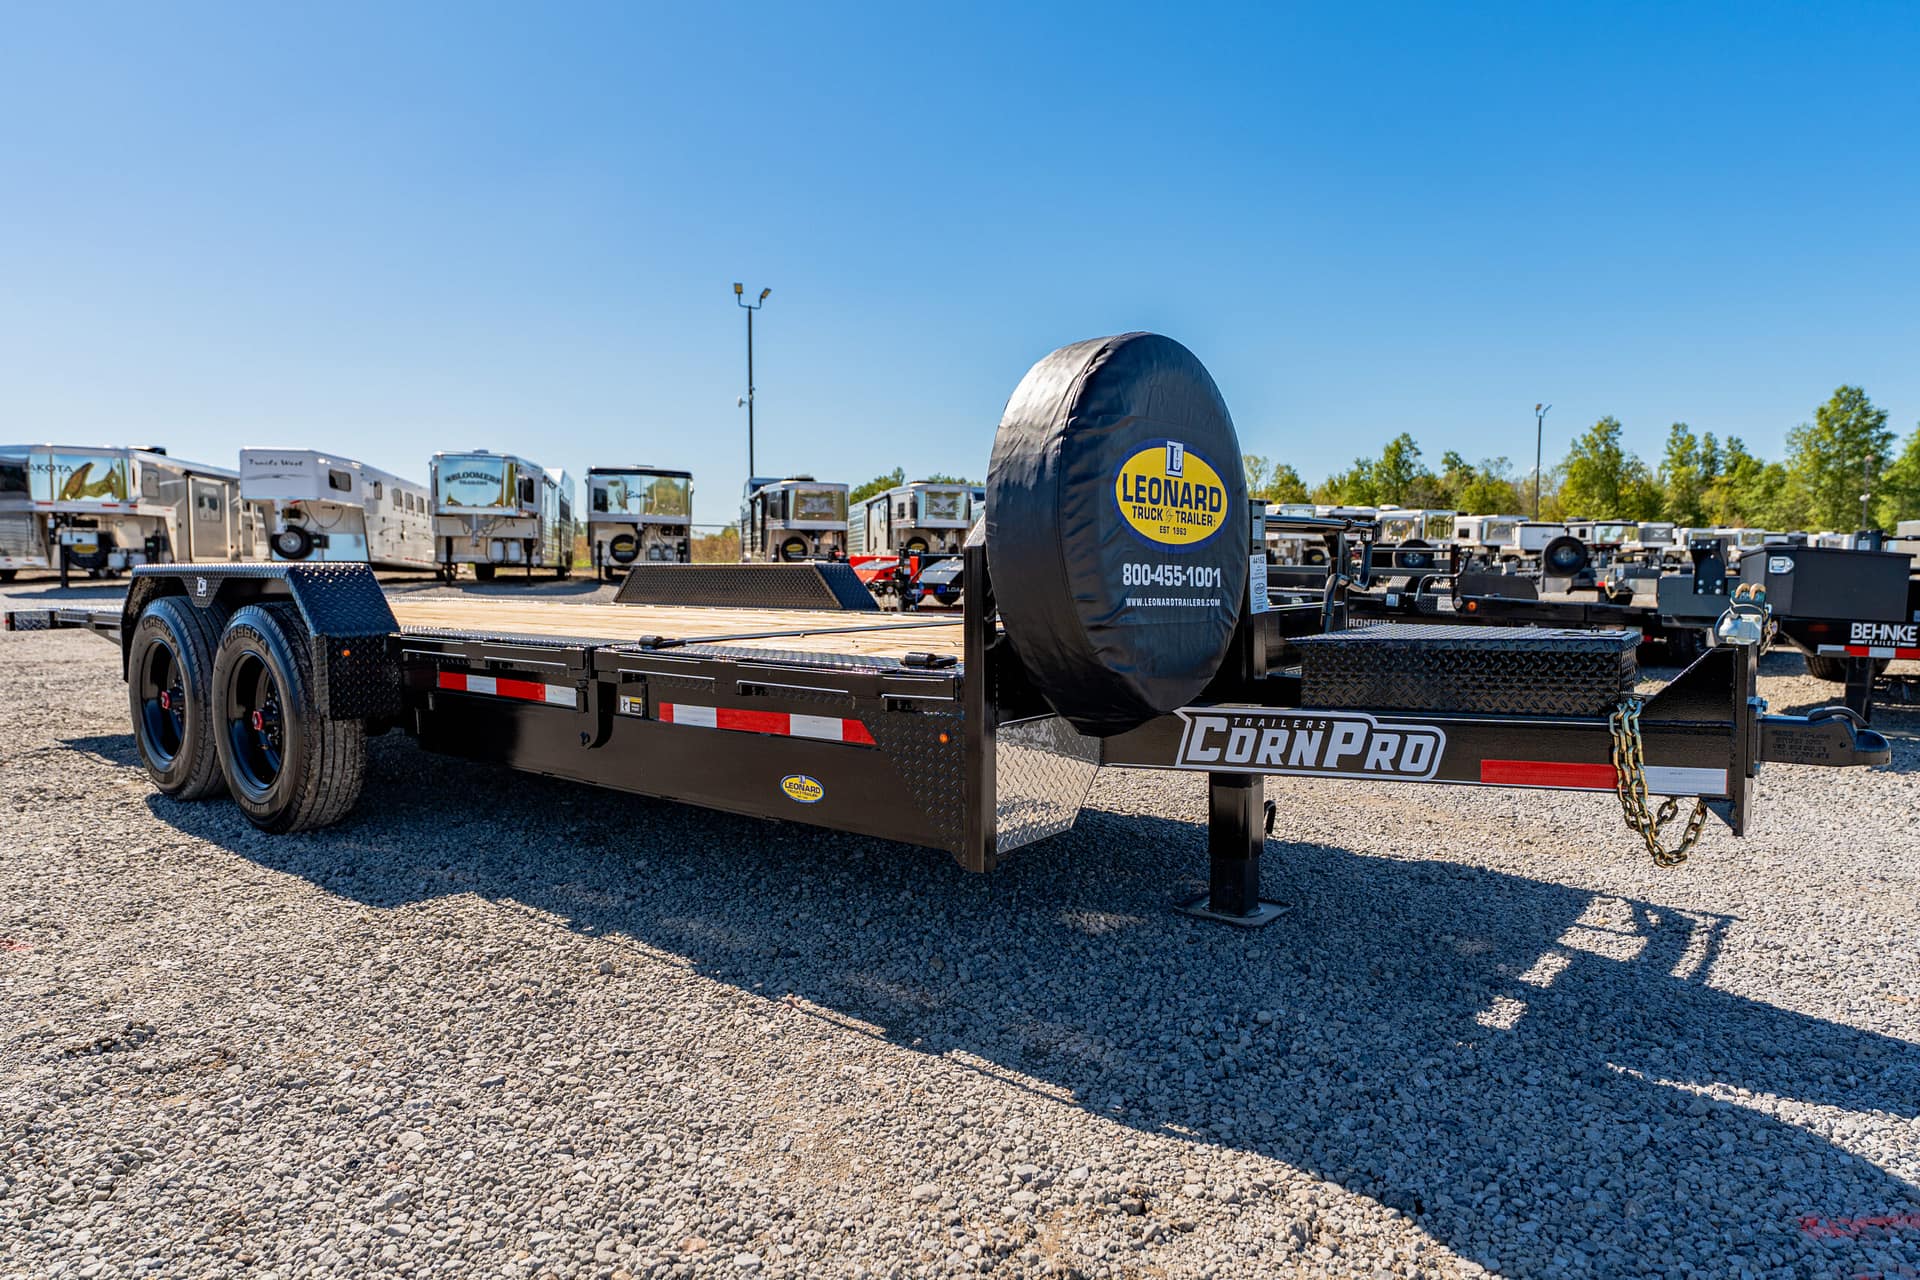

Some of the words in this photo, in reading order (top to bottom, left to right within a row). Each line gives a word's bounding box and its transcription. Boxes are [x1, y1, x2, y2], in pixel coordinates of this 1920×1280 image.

[23, 463, 73, 473] AKOTA
[1122, 473, 1222, 513] LEONARD
[1132, 505, 1163, 521] TRUCK
[1159, 525, 1170, 534] EST
[1125, 597, 1221, 608] WWW.LEONARDTRAILERS.COM
[1850, 622, 1919, 642] BEHNKE
[1233, 717, 1327, 729] TRAILERS
[784, 781, 821, 794] LEONARD
